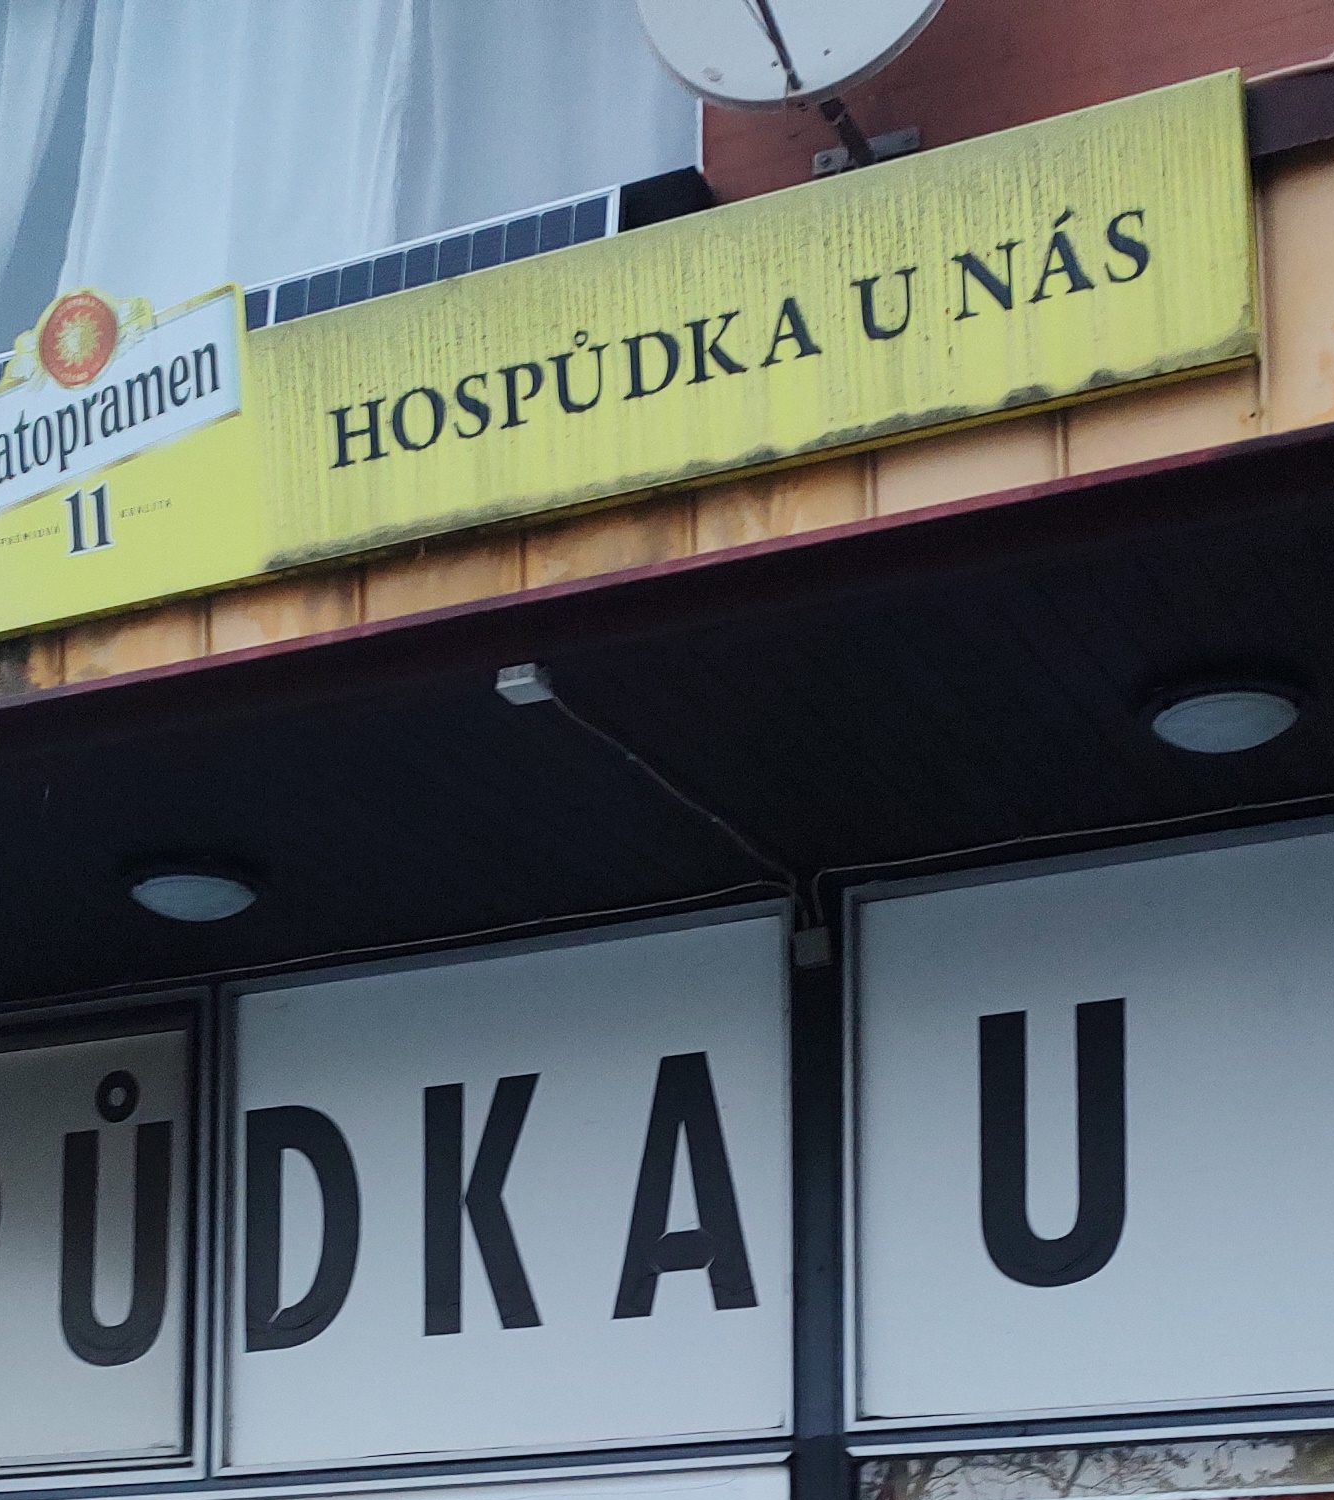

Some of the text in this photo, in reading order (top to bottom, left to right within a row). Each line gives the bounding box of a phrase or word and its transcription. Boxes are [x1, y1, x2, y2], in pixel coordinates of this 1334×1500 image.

[329, 208, 1152, 469] HOSPŮDKA U NÁS
[64, 482, 115, 555] 11
[977, 996, 1127, 1289] U
